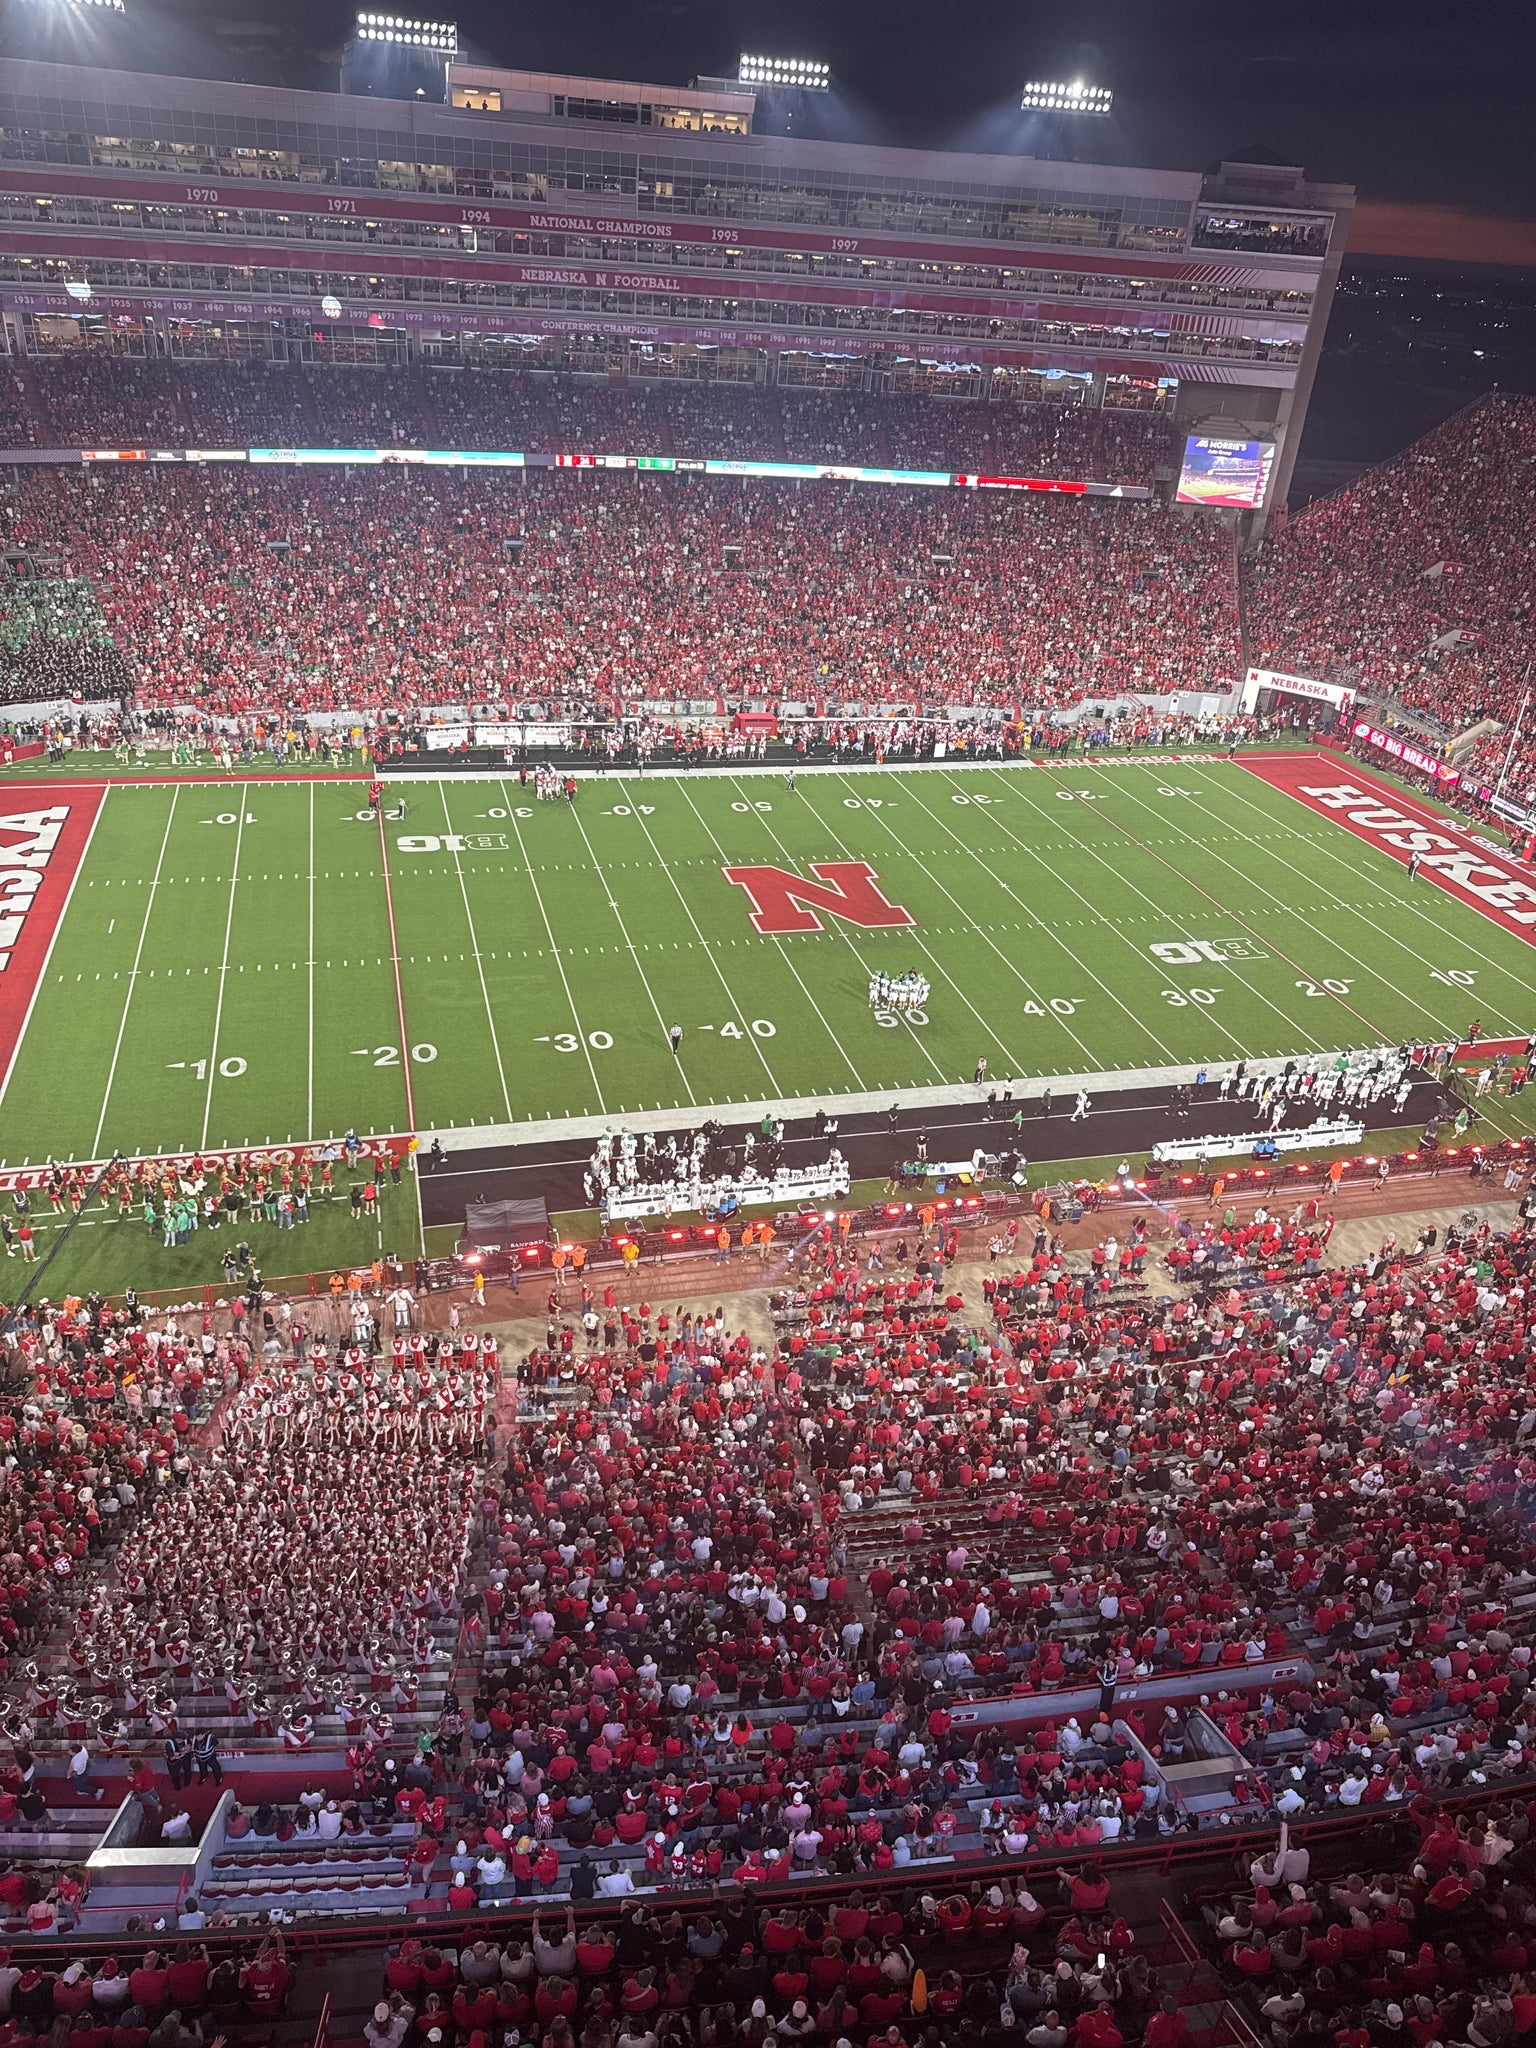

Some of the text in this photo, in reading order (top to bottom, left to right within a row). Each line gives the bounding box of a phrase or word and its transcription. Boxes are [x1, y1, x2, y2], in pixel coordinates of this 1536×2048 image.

[186, 188, 218, 202] 1970
[327, 199, 356, 213] 1971
[461, 210, 491, 223] 1994
[529, 215, 672, 237] NATIONAL CHAMPIONS
[711, 229, 738, 241] 1995
[831, 239, 858, 251] 1997
[521, 269, 680, 290] NEBRASKA N FOOTBALL
[14, 295, 34, 305] 1931
[46, 296, 68, 305] 1932
[110, 299, 131, 308] 1935
[142, 300, 163, 309] 1936
[172, 301, 192, 311] 1937
[204, 303, 224, 312] 1940
[233, 304, 253, 313] 1963
[263, 306, 283, 315] 1964
[291, 307, 311, 316] 1966
[349, 310, 367, 319] 1970
[405, 313, 423, 321] 1972
[433, 315, 451, 323] 1975
[541, 321, 659, 336] CONFERENCE CHAMPIONS
[695, 330, 712, 338] 1982
[720, 331, 736, 340] 1983
[795, 336, 811, 345] 1991
[819, 338, 836, 346] 1992
[1210, 441, 1247, 452] MORRIE'S
[1250, 672, 1259, 681] N
[1271, 677, 1329, 697] NEBRASKA
[1370, 731, 1437, 773] GO BIG BREAD
[1055, 790, 1097, 801] 20
[1156, 786, 1192, 797] 10
[843, 798, 883, 808] 40
[951, 794, 993, 805] 30
[612, 804, 656, 816] 40
[730, 801, 773, 812] 50
[488, 807, 534, 818] 30
[216, 813, 258, 824] 10
[719, 860, 919, 935] N
[1429, 969, 1475, 987] 10
[1295, 978, 1350, 997] 20
[1160, 988, 1216, 1007] 30
[1023, 998, 1075, 1017] 40
[874, 1009, 930, 1028] 50
[719, 1019, 777, 1040] 40
[554, 1030, 614, 1053] 30
[372, 1043, 438, 1066] 20
[190, 1056, 248, 1080] 10
[253, 1387, 267, 1398] N
[297, 1391, 306, 1399] N
[241, 1408, 253, 1418] N
[276, 1404, 288, 1414] N
[665, 1796, 676, 1805] 12
